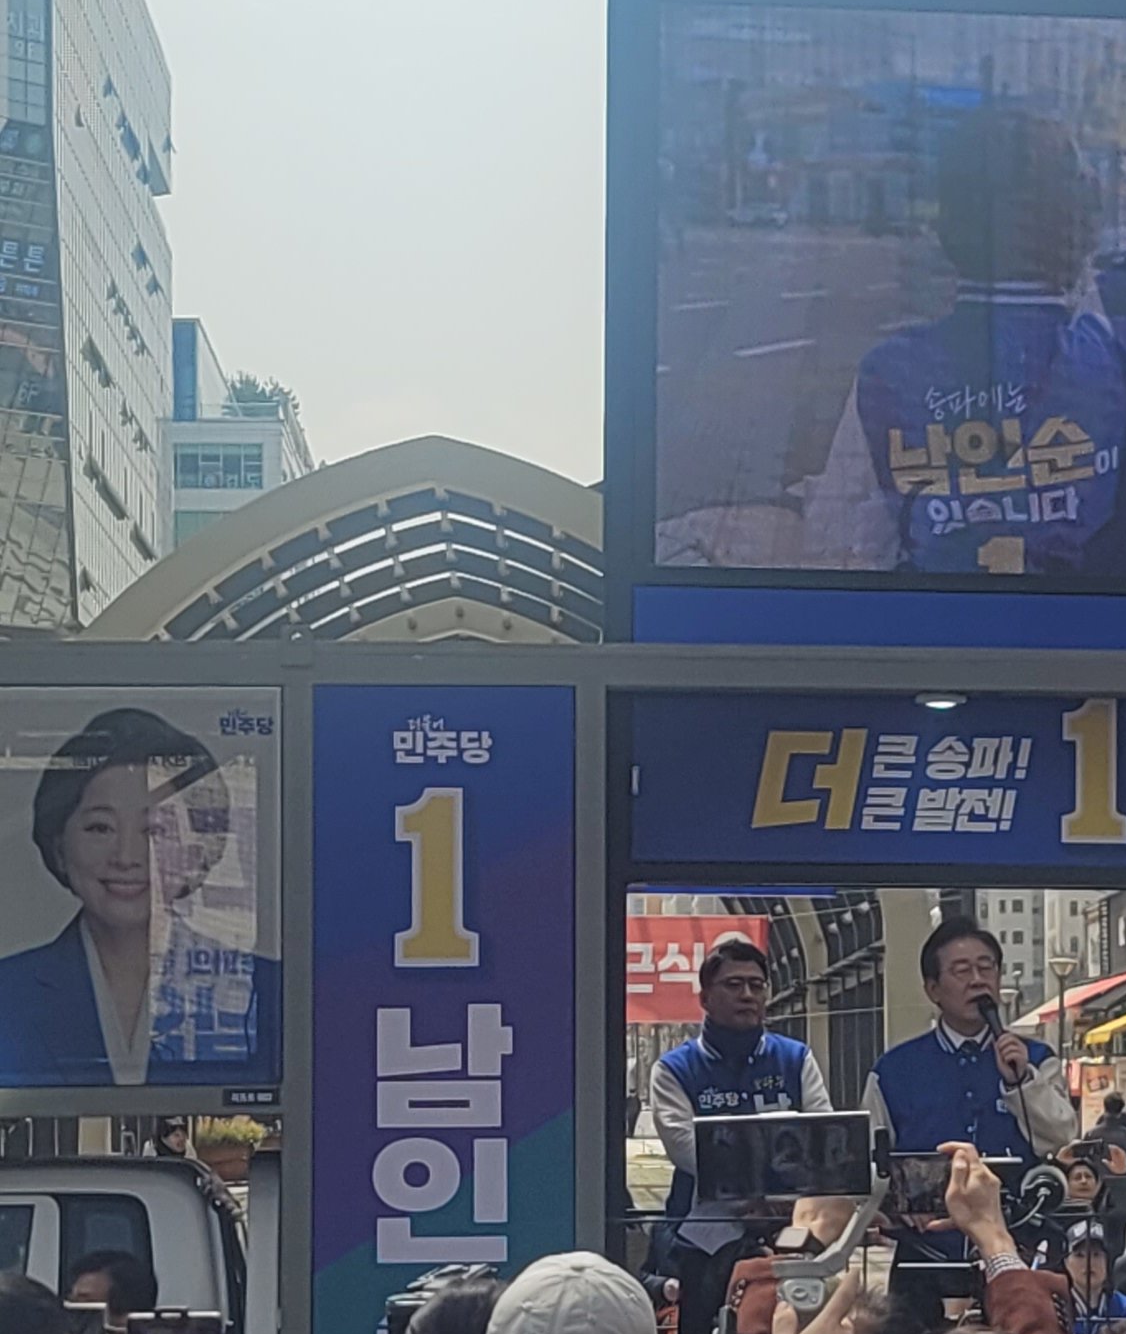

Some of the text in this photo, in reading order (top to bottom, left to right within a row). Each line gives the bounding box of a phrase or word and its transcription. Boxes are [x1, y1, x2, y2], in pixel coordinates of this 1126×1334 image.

[924, 383, 1028, 423] 송파에는
[888, 413, 1120, 496] 남인순이
[926, 486, 1081, 536] 있습니다
[220, 716, 274, 737] 민주당
[392, 730, 494, 765] 민주당
[750, 727, 1033, 831] 더 큰 송파!
[860, 786, 1018, 833] 큰 발전!
[393, 786, 481, 968] 1
